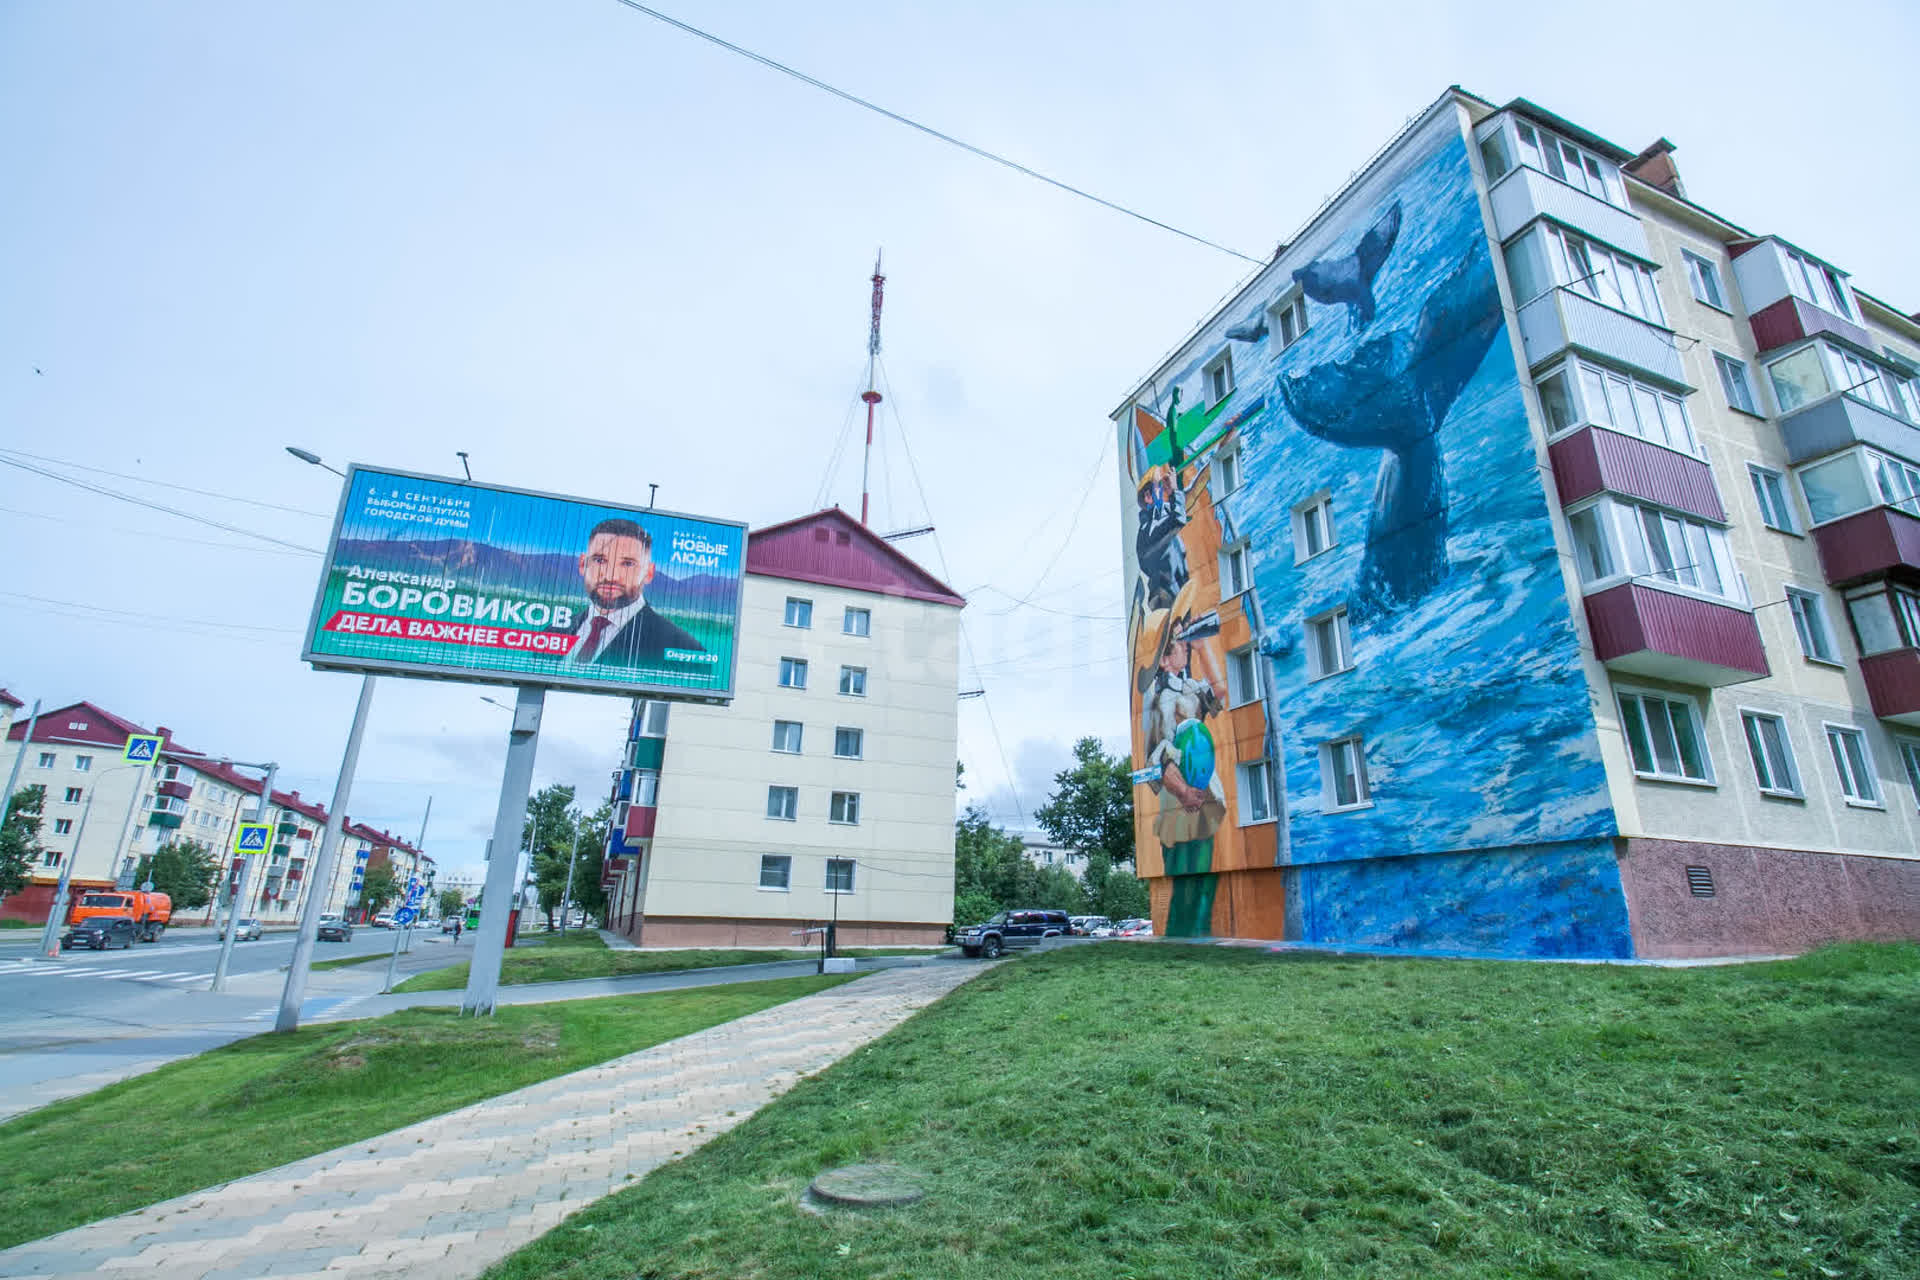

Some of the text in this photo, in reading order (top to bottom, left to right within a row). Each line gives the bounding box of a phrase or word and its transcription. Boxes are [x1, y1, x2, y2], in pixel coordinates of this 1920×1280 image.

[366, 497, 471, 519] ВЫБОРЫ ДЕПУТАТА
[404, 492, 471, 509] СЕНТЯБРЯ
[364, 507, 469, 529] ГОРОДСКОЙ ДУМЫ
[672, 537, 729, 556] НОВЫЕ
[670, 551, 719, 568] ЛЮДИ
[347, 564, 456, 591] Александр
[341, 581, 573, 629] БОРОВИКОВ
[336, 613, 569, 652] ДЕЛА ВАЖНЕЕ СЛОВ!
